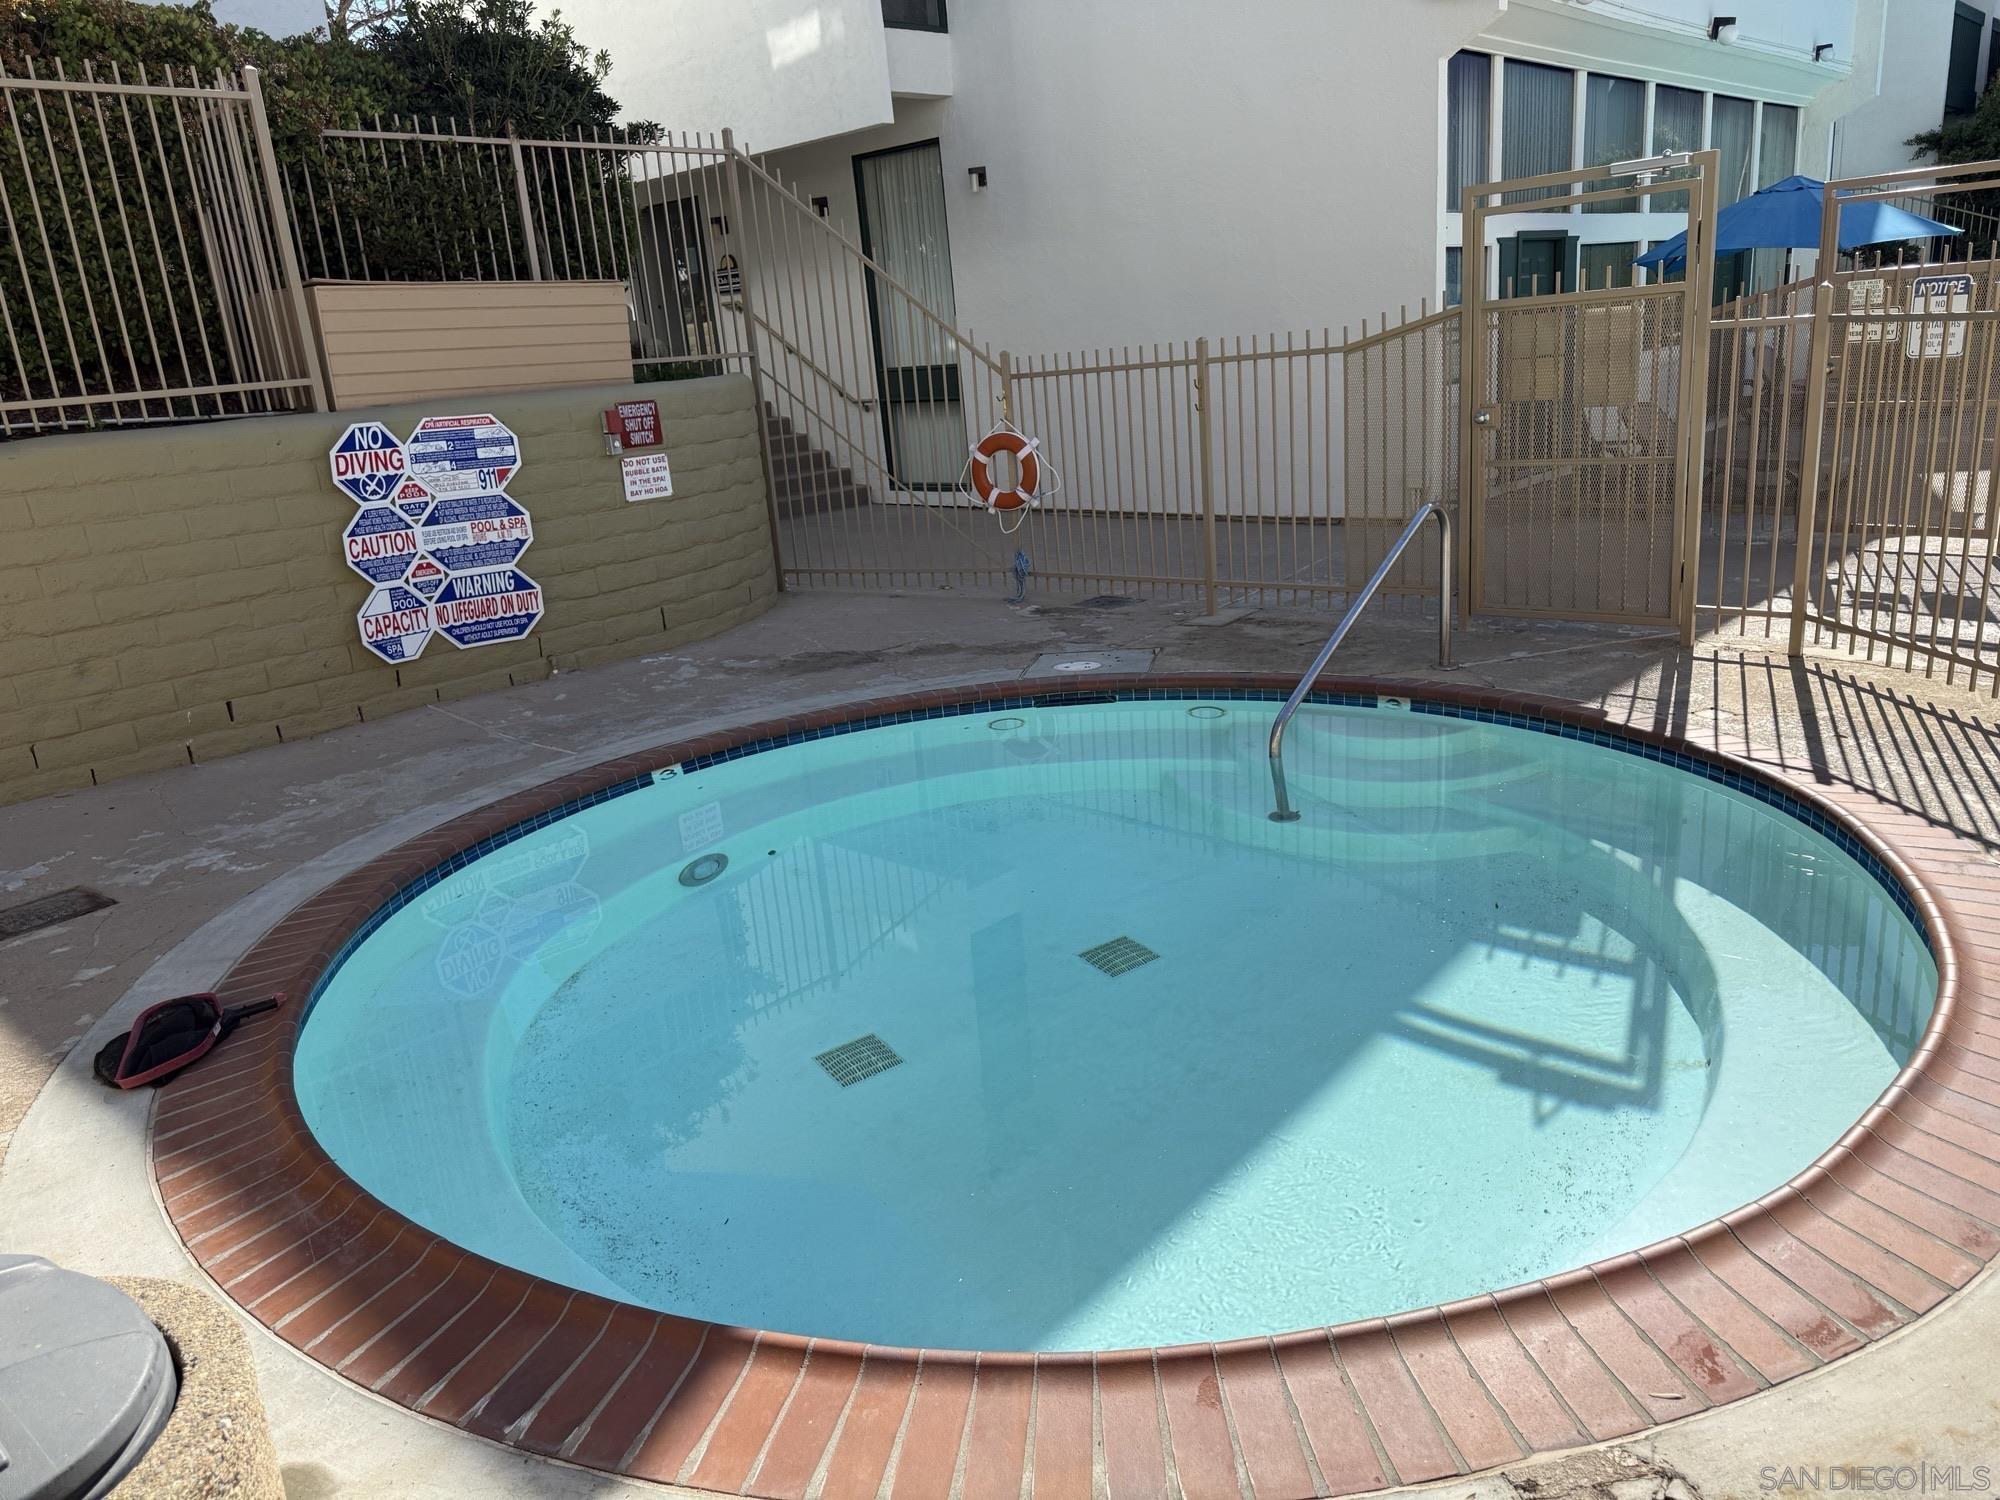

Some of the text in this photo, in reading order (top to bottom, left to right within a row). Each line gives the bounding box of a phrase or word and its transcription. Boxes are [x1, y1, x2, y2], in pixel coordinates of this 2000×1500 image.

[619, 403, 655, 417] EMERGENCY
[461, 418, 490, 426] RESPIRATION
[625, 417, 654, 432] SHUT OFF
[355, 426, 382, 450] NO
[630, 431, 654, 445] SWITCH
[448, 442, 454, 450] 2
[335, 449, 404, 476] DIVING
[410, 454, 416, 463] 3
[636, 458, 650, 466] NOT
[451, 462, 456, 470] 4
[625, 468, 650, 477] BUBBLE
[478, 469, 498, 490] 911
[470, 517, 527, 533] POOL & SPA
[349, 531, 416, 559] CAUTION
[417, 580, 439, 588] SHUT-OFF
[453, 571, 515, 598] WARNING
[393, 598, 419, 610] POOL
[435, 591, 540, 625] NO LIFEGUARD ON DUTY
[364, 607, 428, 639] CAPACITY
[452, 626, 471, 635] CHILDREN
[471, 624, 486, 632] SHOULD
[464, 633, 480, 641] WITHOUT
[494, 627, 519, 636] SUPERVISION
[387, 644, 402, 654] SPA
[659, 769, 677, 780] 3
